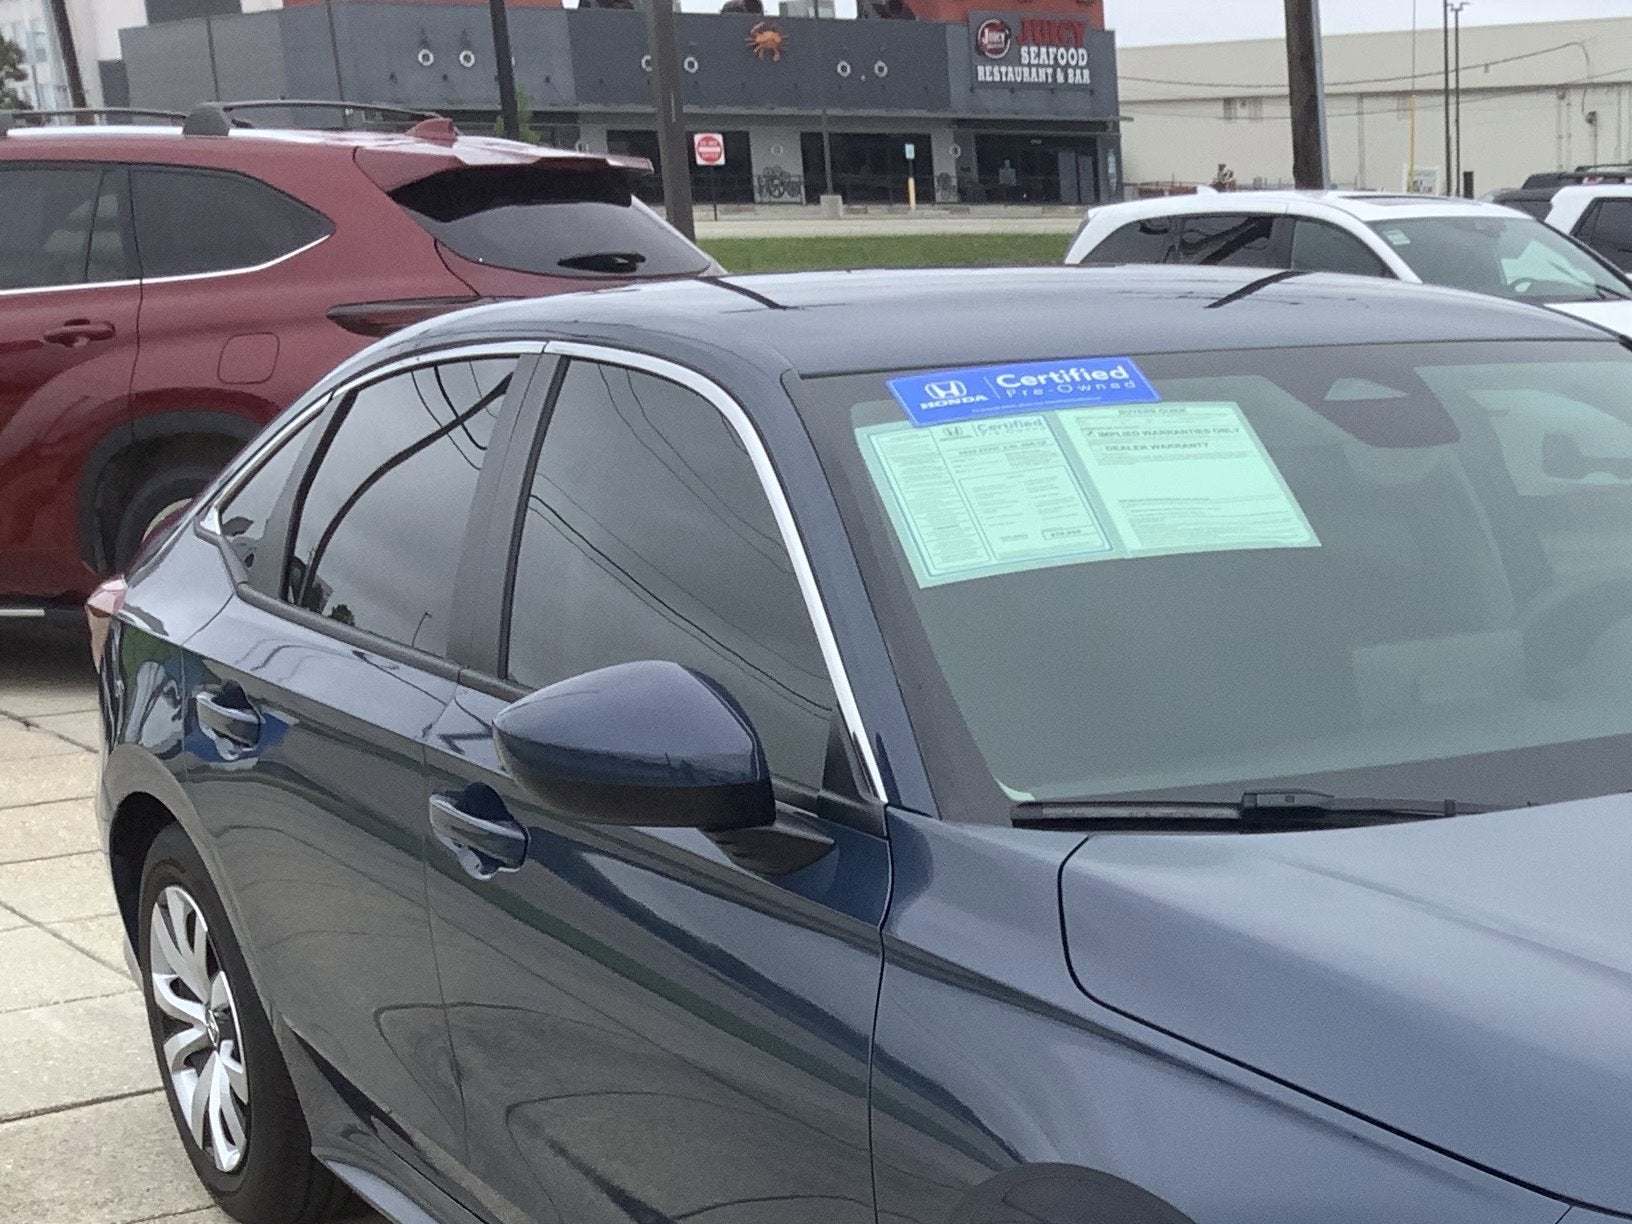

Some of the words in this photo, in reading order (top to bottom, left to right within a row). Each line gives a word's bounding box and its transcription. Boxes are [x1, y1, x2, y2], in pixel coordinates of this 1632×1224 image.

[1017, 19, 1085, 47] JUICY
[1020, 46, 1089, 66] SEAFOOD
[977, 65, 1053, 83] RESTAURANT
[1056, 67, 1065, 83] &
[1067, 68, 1091, 84] BAR
[995, 365, 1130, 389] Certified
[1005, 380, 1137, 399] Pre-Owned
[920, 394, 990, 410] HONDA
